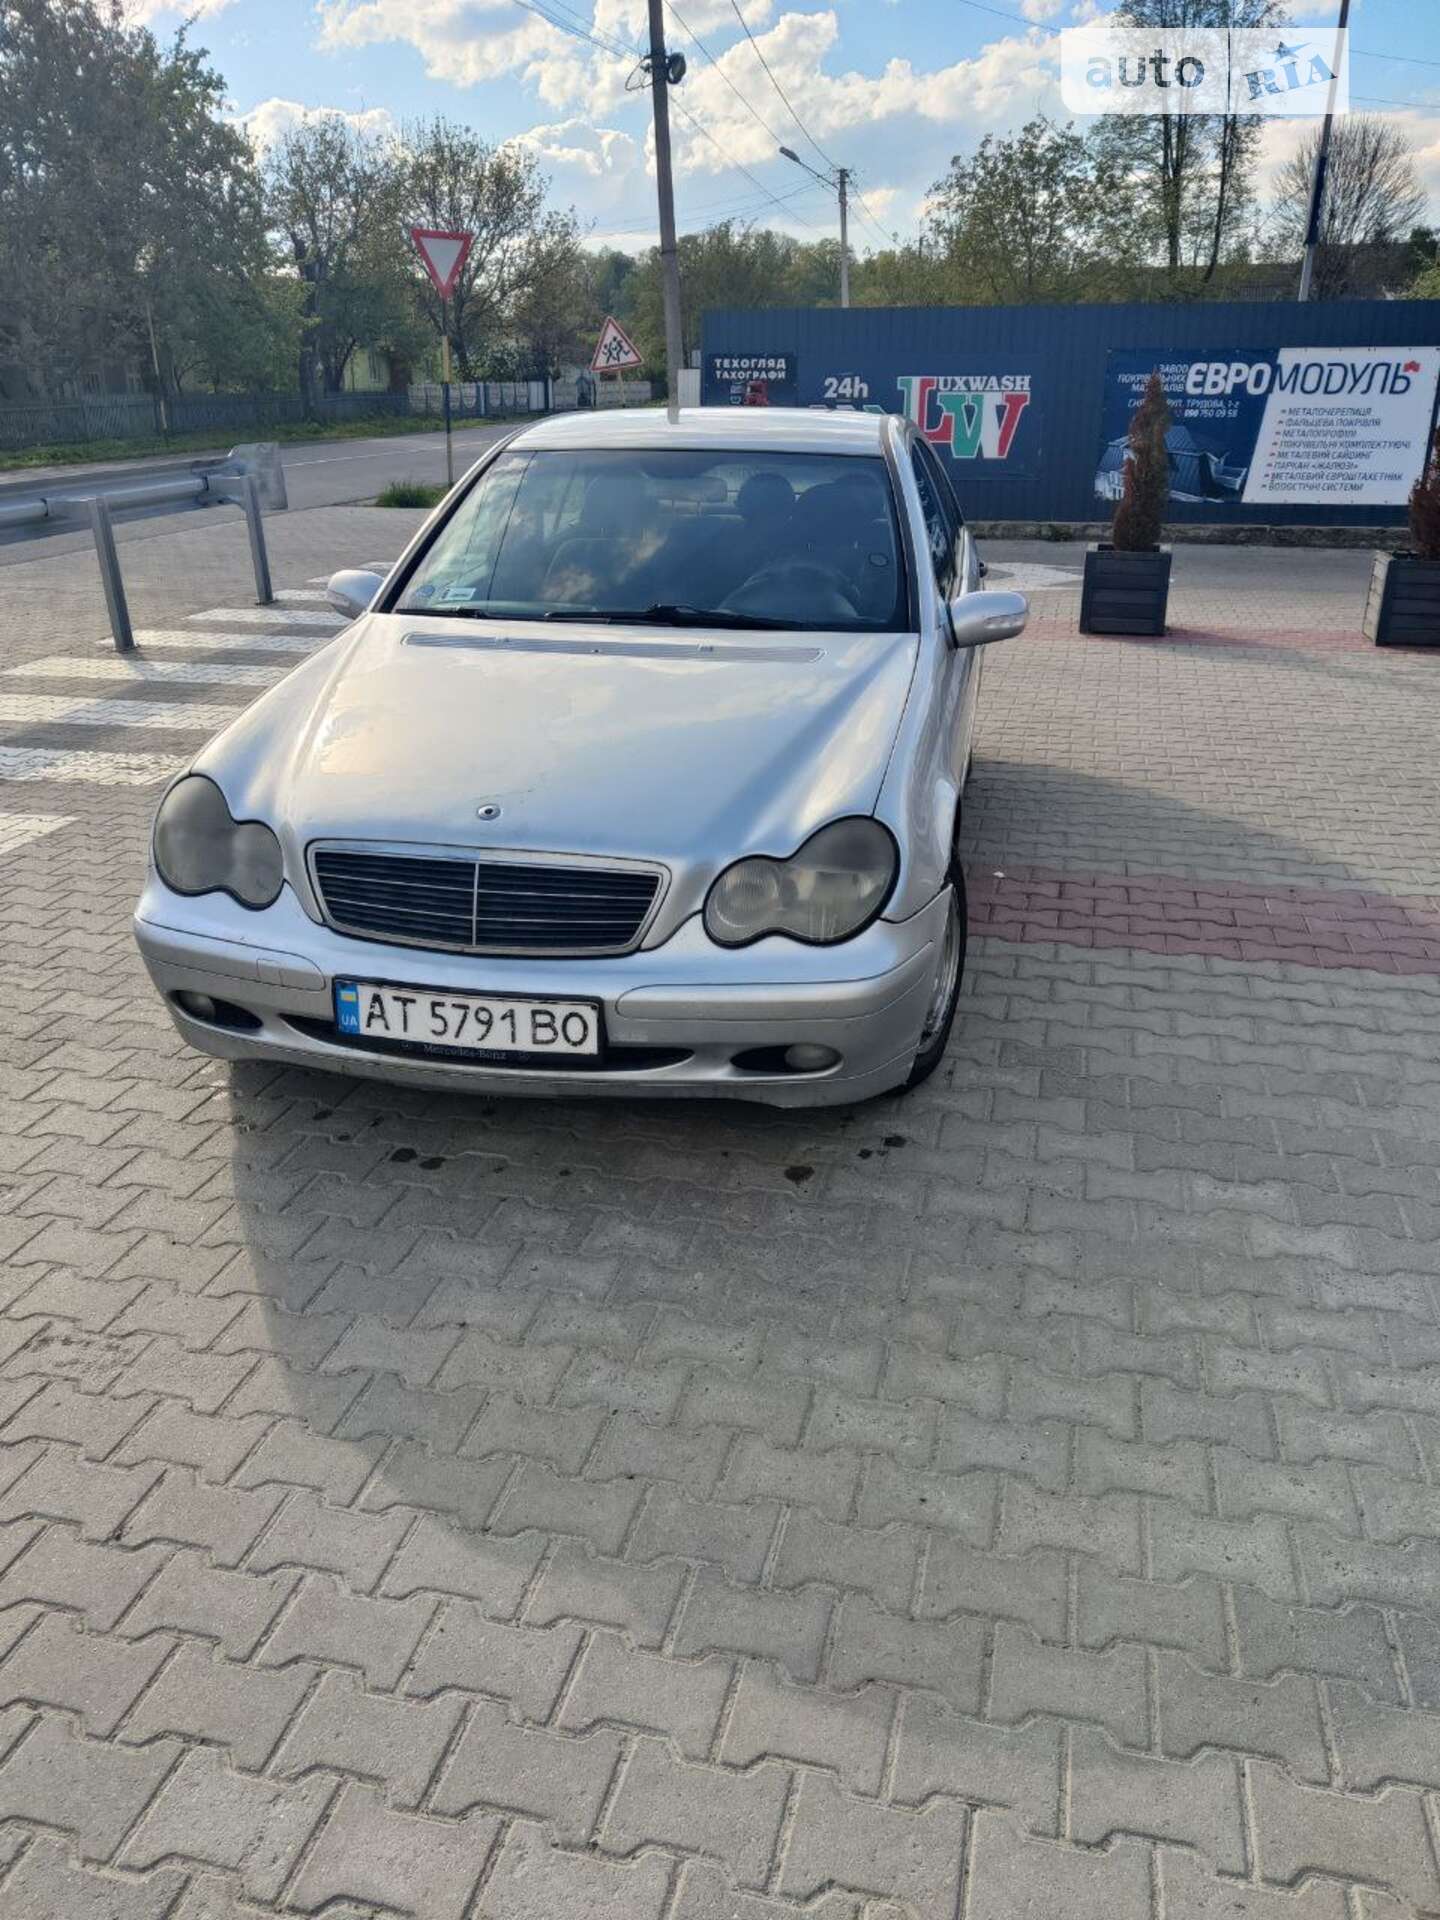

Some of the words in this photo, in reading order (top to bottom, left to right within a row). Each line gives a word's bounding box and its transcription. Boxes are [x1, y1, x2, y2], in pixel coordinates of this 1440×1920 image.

[714, 358, 787, 369] ТЕХОГЛЯД
[714, 371, 786, 380] ТАХОГРАФИ
[824, 376, 869, 399] 24h
[341, 1012, 358, 1027] UA
[366, 992, 416, 1033] AT
[430, 1000, 517, 1044] 5791
[531, 1008, 589, 1047] BO
